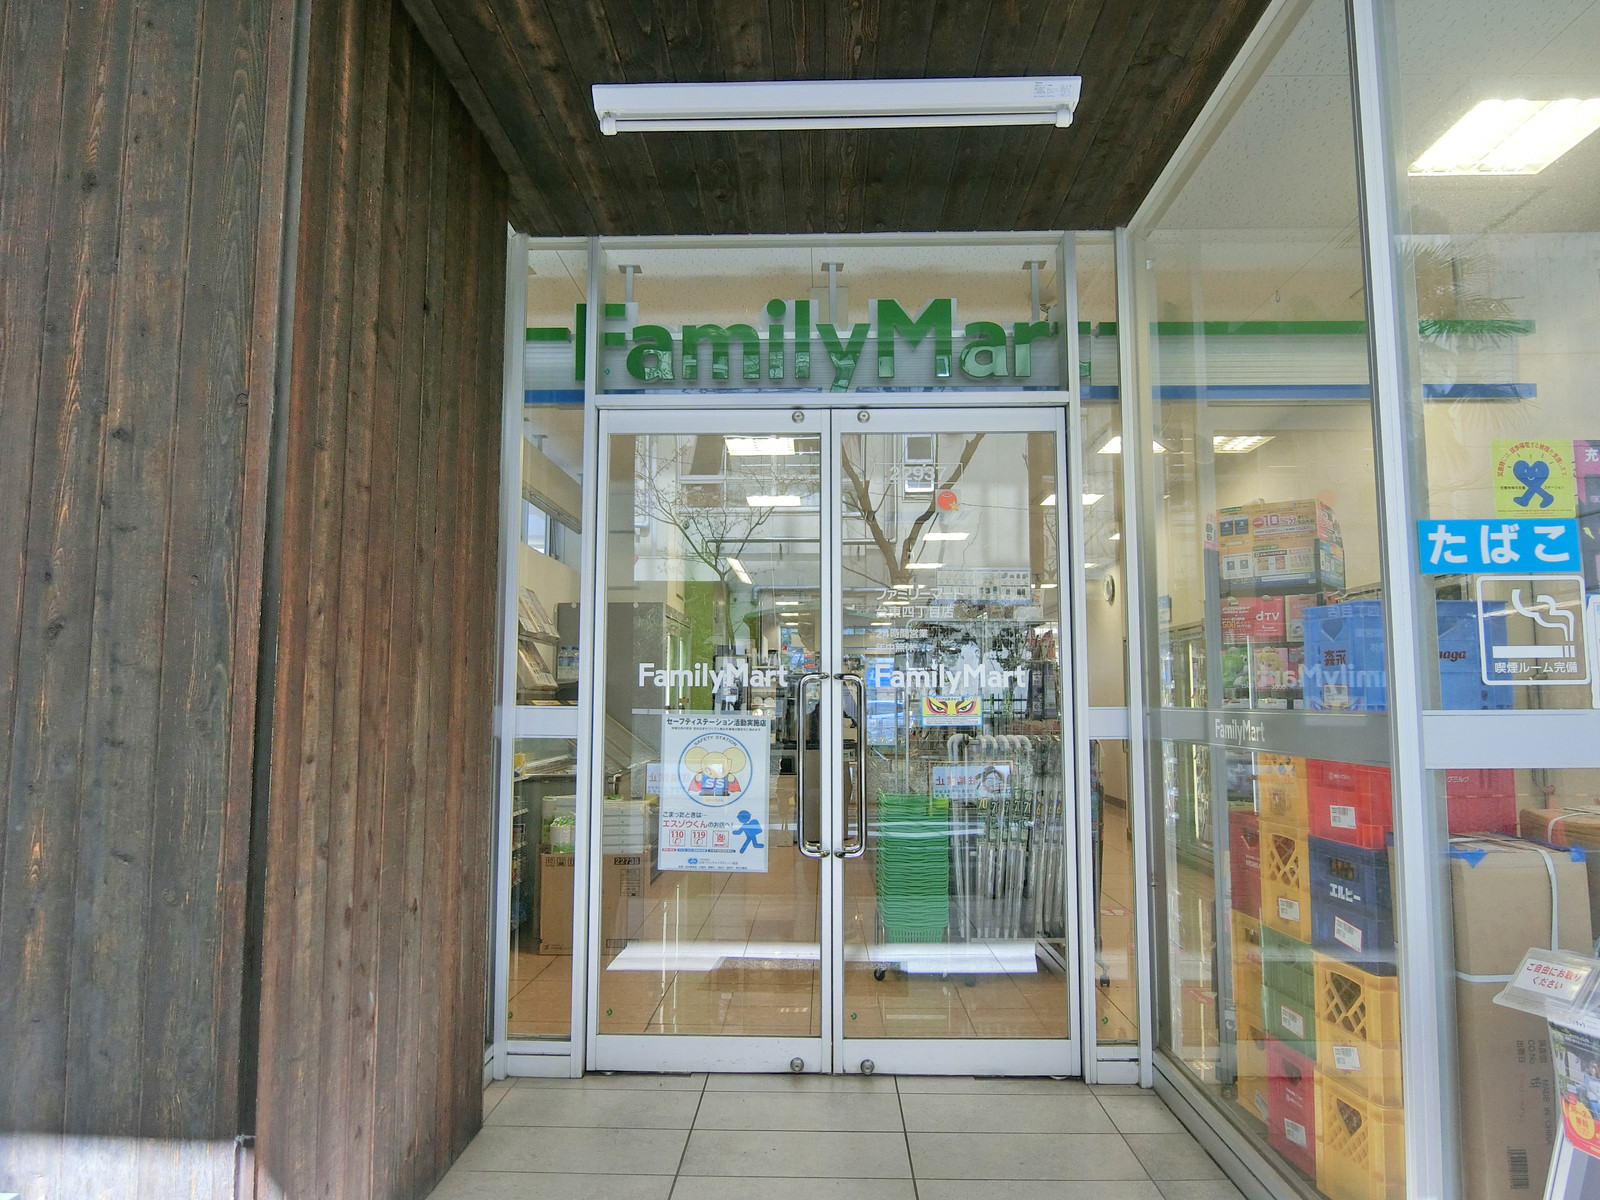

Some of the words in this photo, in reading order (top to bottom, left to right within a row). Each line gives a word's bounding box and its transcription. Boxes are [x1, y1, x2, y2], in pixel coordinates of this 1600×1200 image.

[890, 467, 948, 482] 22937
[1427, 523, 1571, 565] たばこ
[875, 587, 965, 602] ファミリーマート
[876, 605, 954, 618] 台東四丁目店
[1255, 610, 1280, 621] dTV
[1324, 650, 1347, 667] 森永
[1494, 662, 1578, 674] 喫煙ルーム完備
[638, 662, 789, 694] FamilyMart
[874, 663, 1027, 695] FamilyMart
[666, 717, 767, 727] セーフティステーション活動実施店
[1214, 717, 1266, 747] FamilyMart
[693, 735, 715, 747] SAFETY
[715, 735, 738, 747] STATION
[705, 778, 724, 789] SS
[670, 830, 684, 838] 110
[692, 831, 706, 839] 119
[1526, 962, 1582, 982] ご自由にお取り
[1531, 976, 1564, 990] ください
